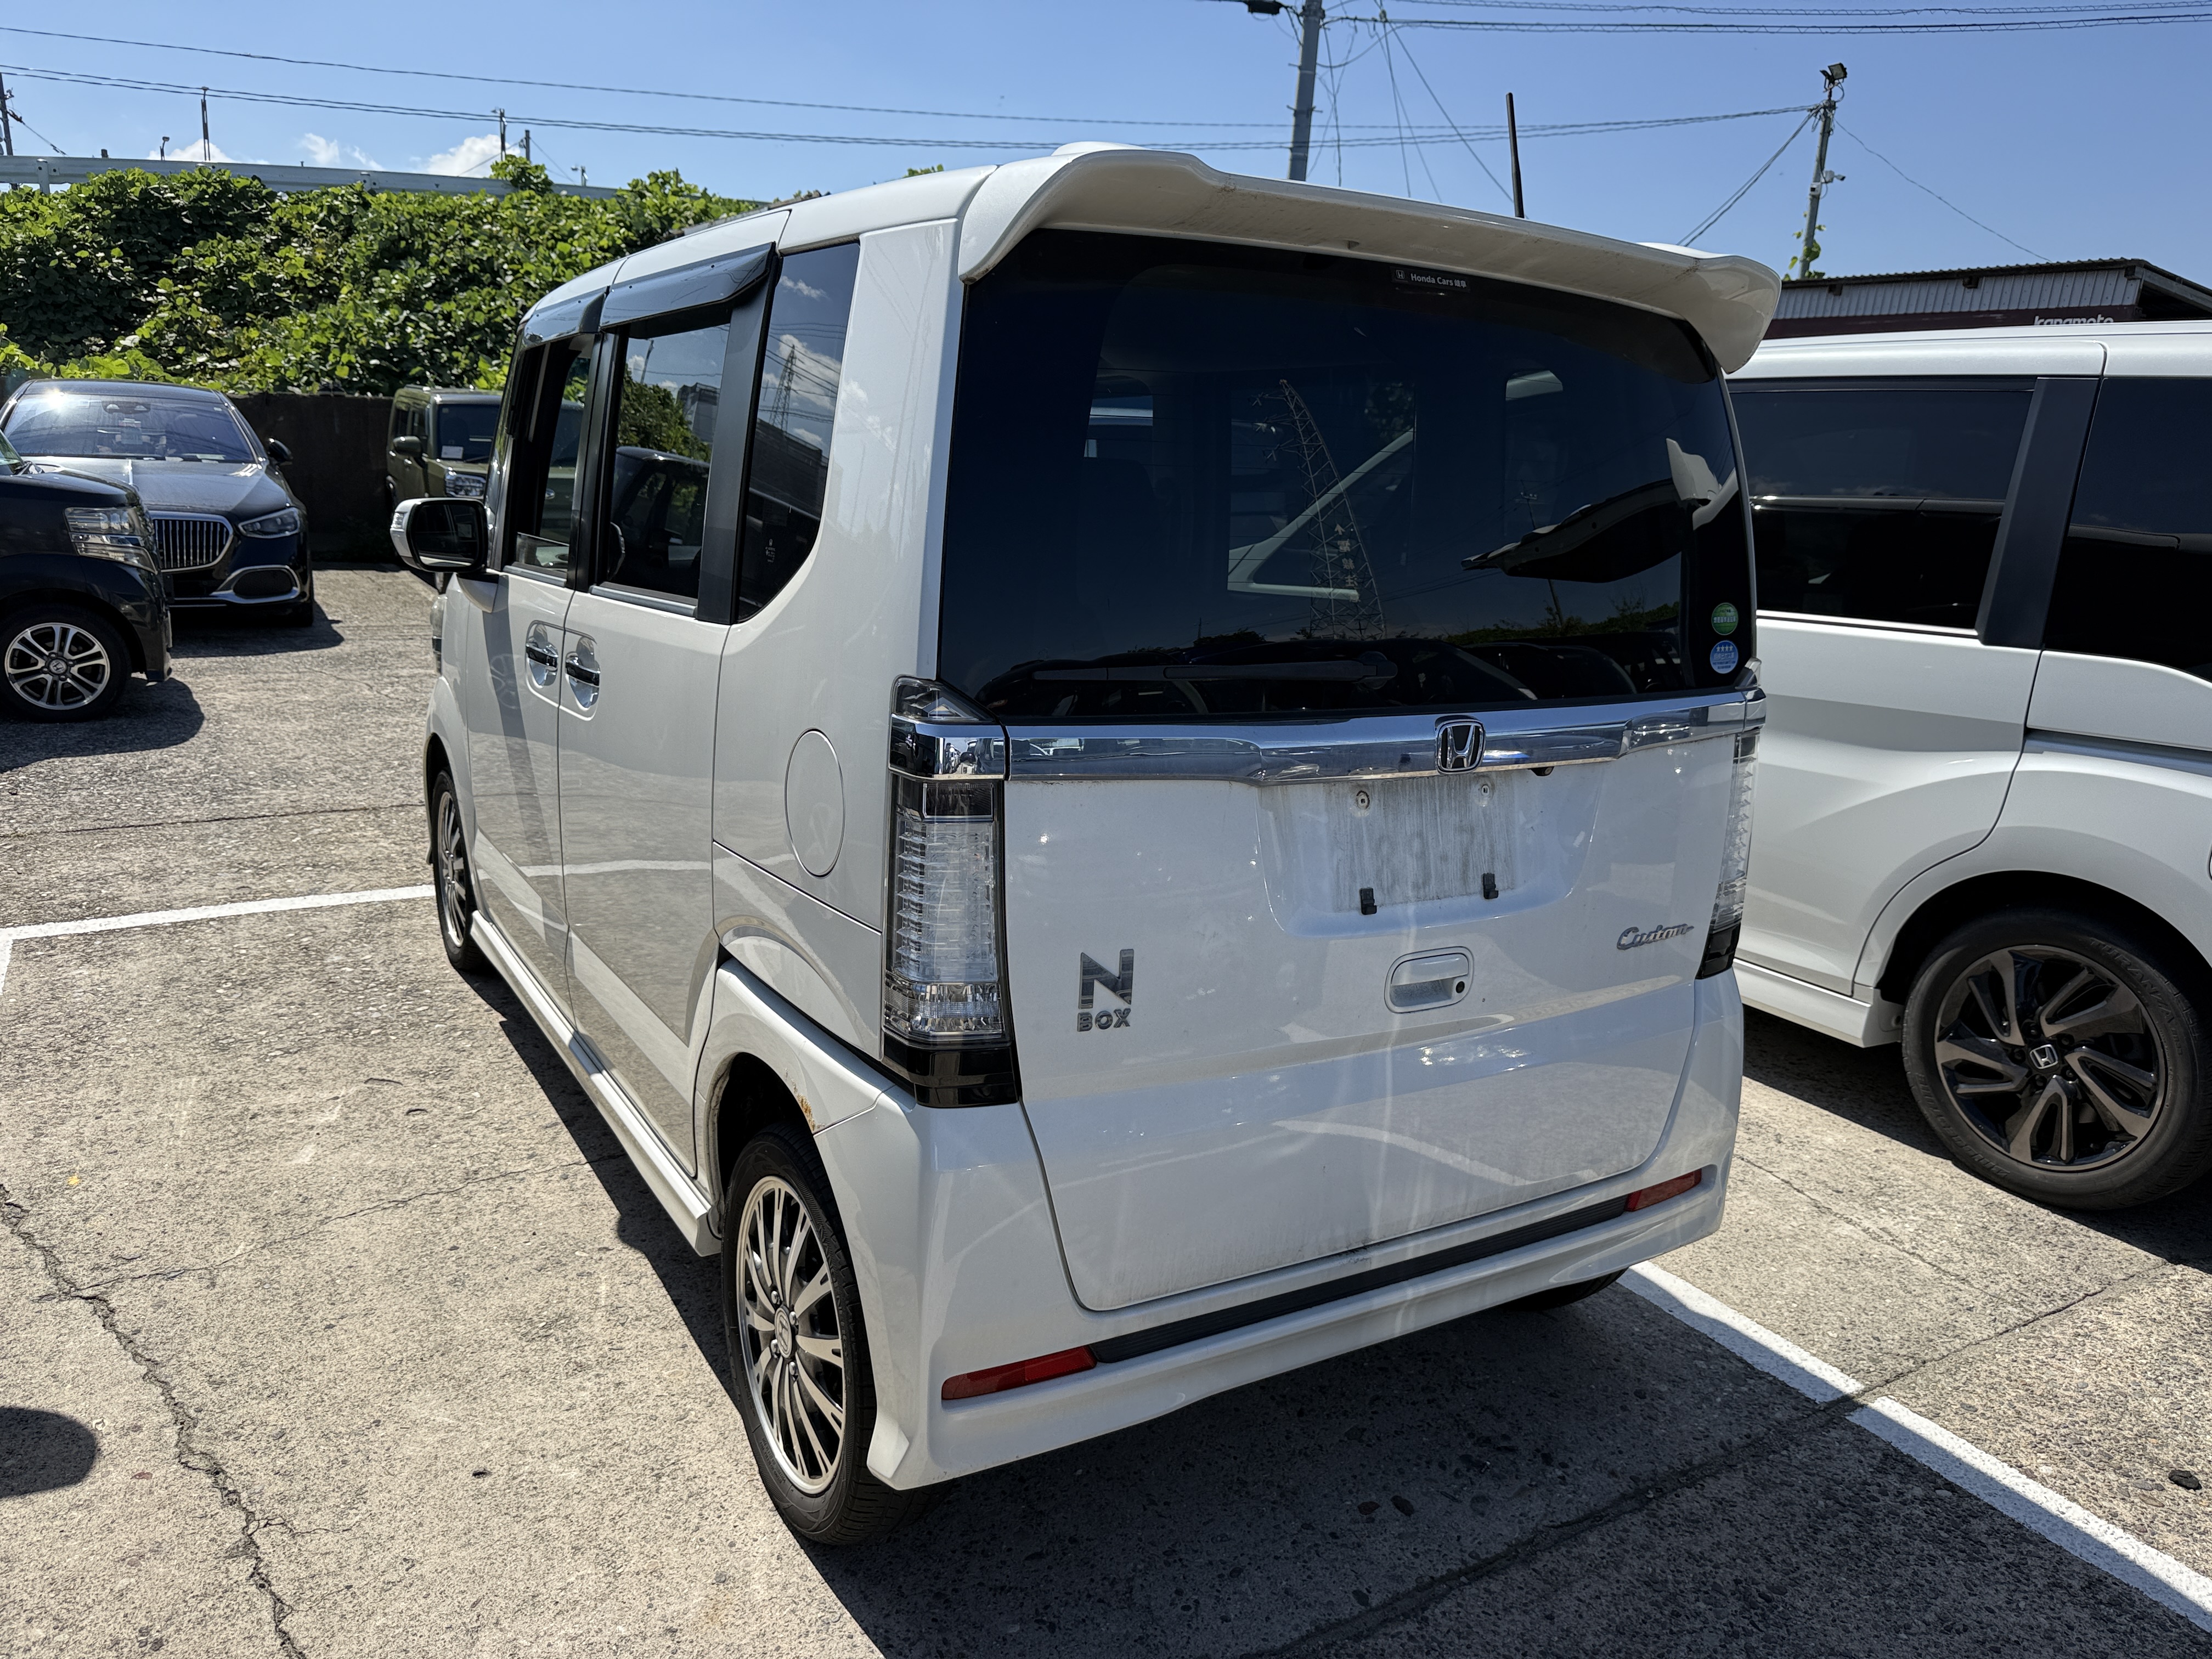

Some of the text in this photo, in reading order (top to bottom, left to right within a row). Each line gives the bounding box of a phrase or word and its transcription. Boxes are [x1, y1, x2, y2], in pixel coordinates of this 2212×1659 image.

[1410, 273, 1436, 284] Honda
[1437, 276, 1454, 286] Cars
[1616, 923, 1695, 950] Custom
[1078, 949, 1135, 1009] N
[1076, 1008, 1132, 1032] BOX
